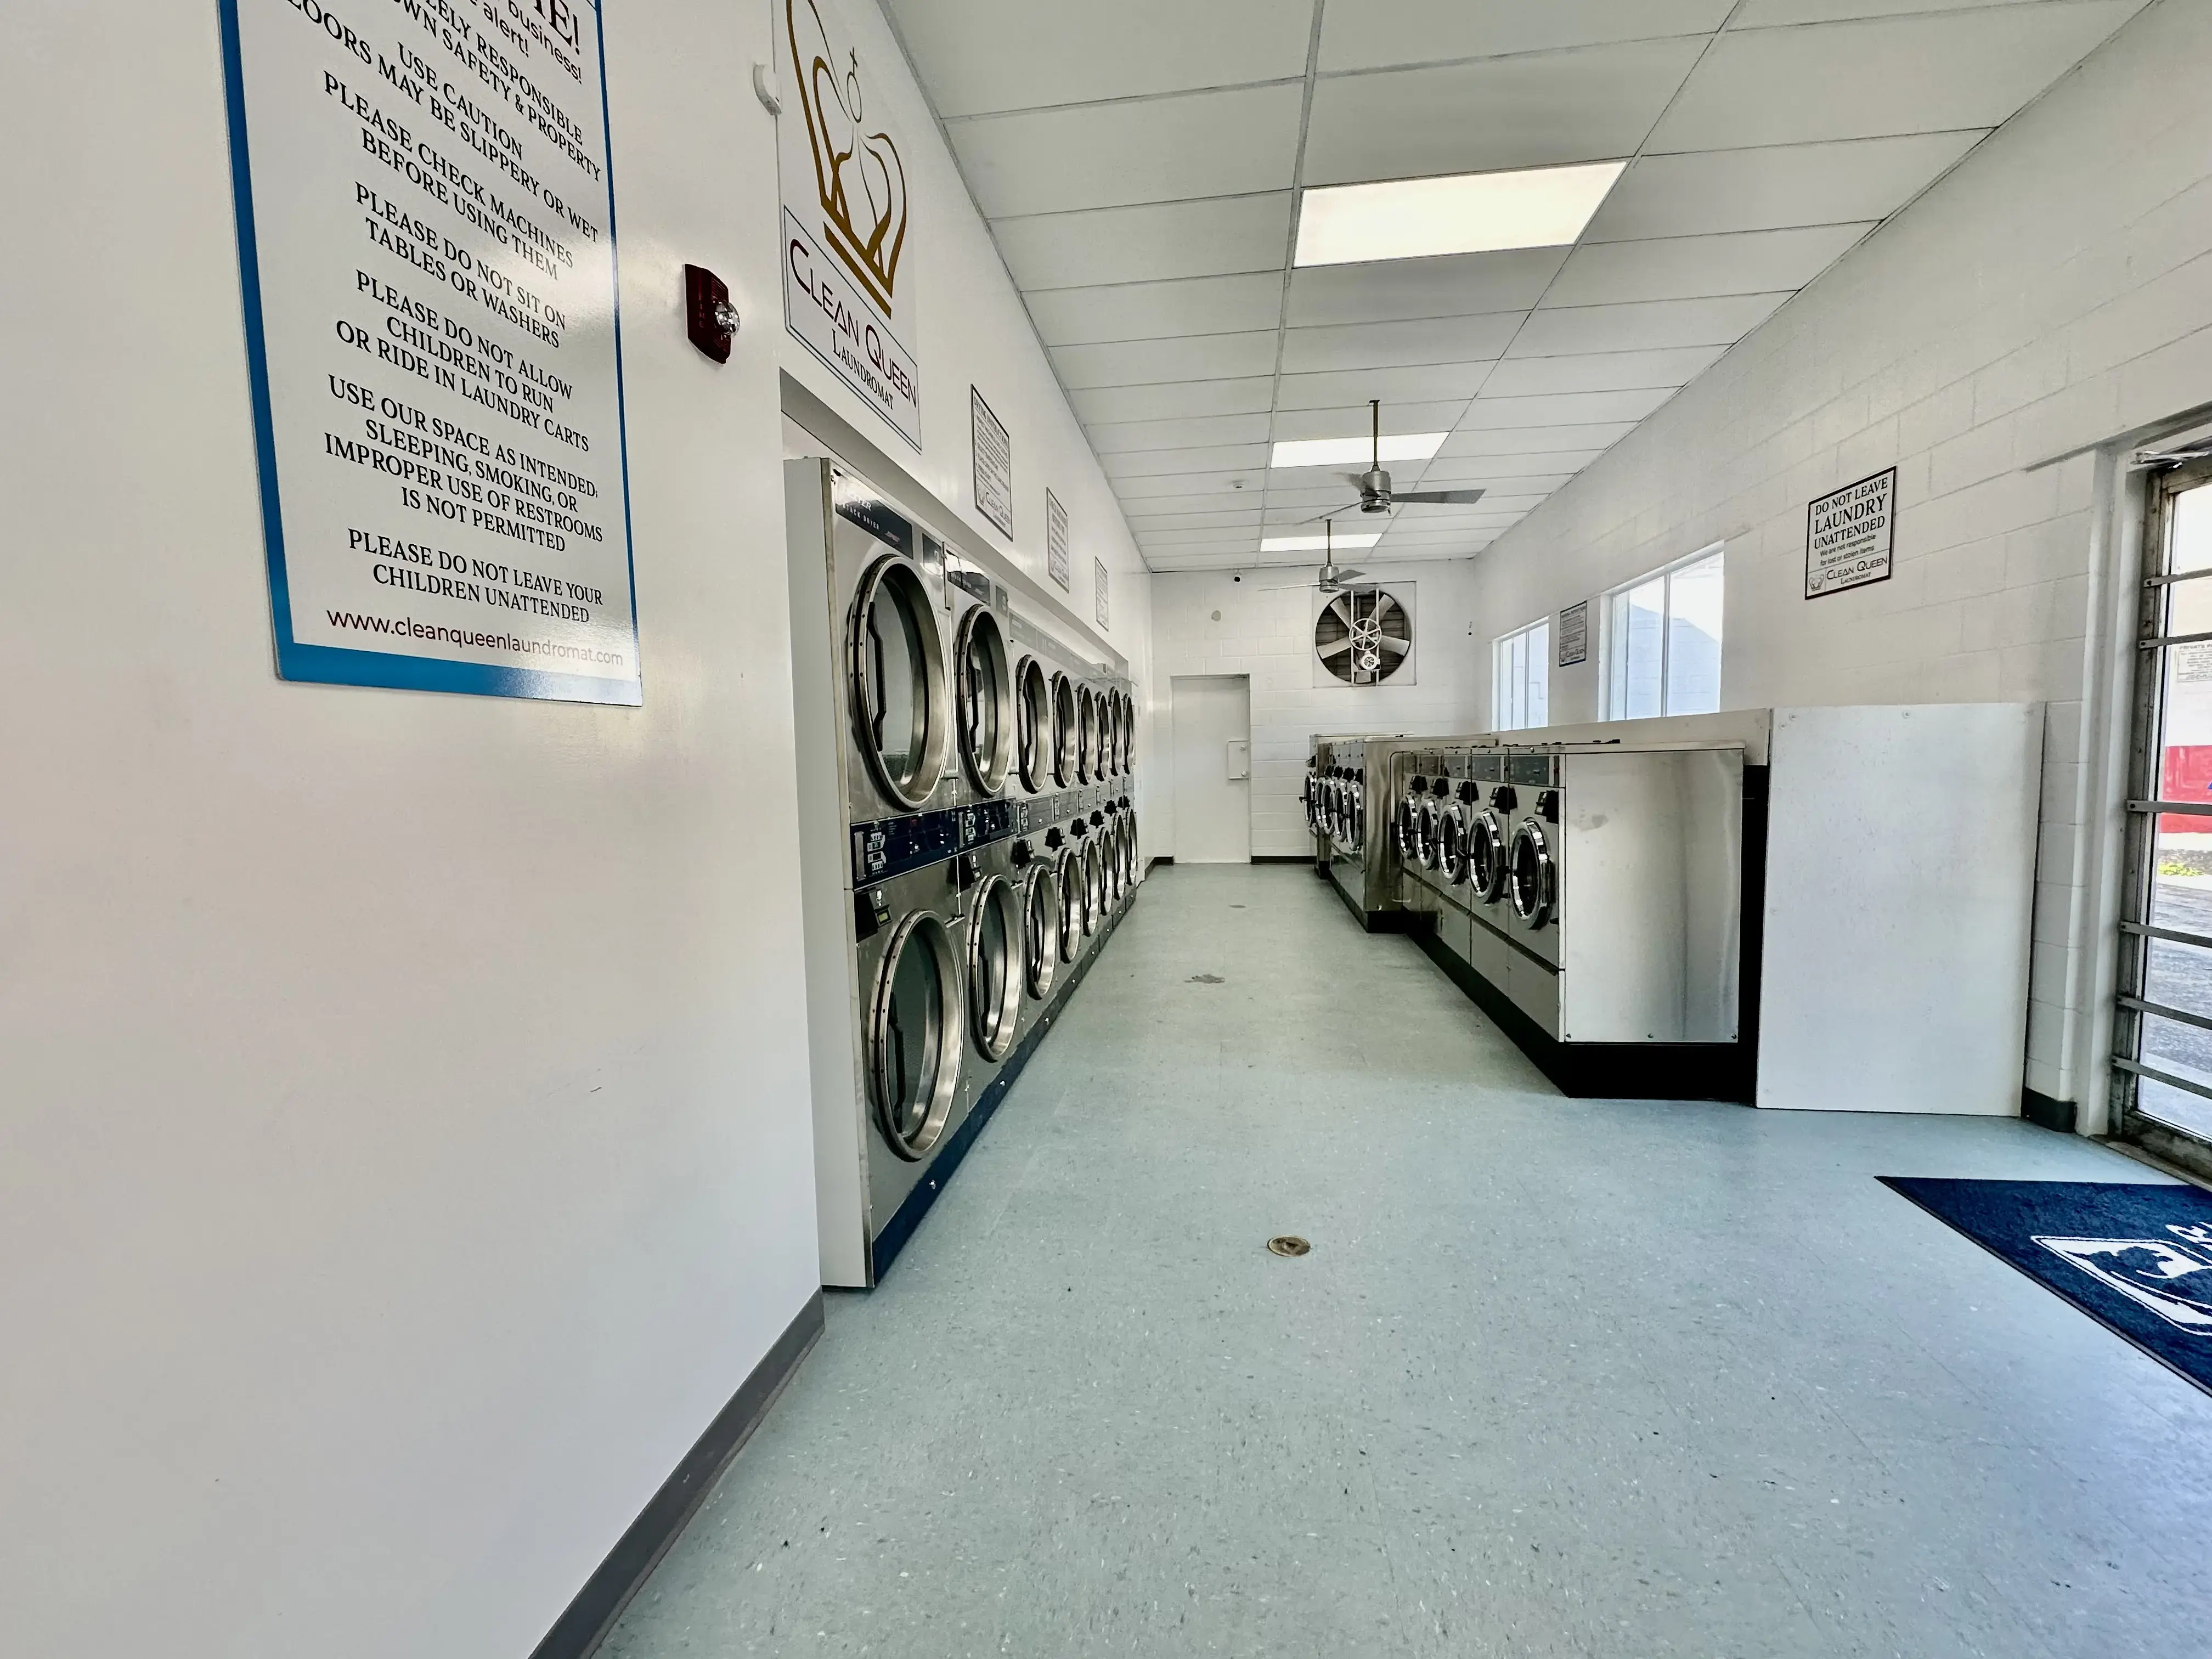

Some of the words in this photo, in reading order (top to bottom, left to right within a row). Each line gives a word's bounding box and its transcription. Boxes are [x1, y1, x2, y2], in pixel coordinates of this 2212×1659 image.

[483, 2, 529, 58] alert!
[393, 0, 437, 38] WN
[443, 29, 511, 101] SAFETY
[515, 94, 524, 115] &
[527, 104, 601, 182] PROPERTY
[398, 41, 438, 92] USE
[443, 83, 522, 161] CAUTION
[476, 32, 583, 146] RESPONSIBLE
[324, 70, 412, 153] PLEASE
[419, 143, 486, 206] CHECK
[490, 193, 573, 268] MACHINES
[378, 53, 424, 105] MAY
[430, 95, 455, 132] BE
[460, 121, 540, 197] SLIPPERY
[544, 189, 565, 218] OR
[567, 206, 598, 243] WET
[361, 127, 448, 205] BEFORE
[453, 192, 507, 244] USING
[511, 234, 557, 280] THEM
[355, 181, 438, 251] PLEASE
[443, 238, 471, 270] DO
[477, 259, 512, 296] NOT
[517, 286, 540, 313] SIT
[545, 305, 565, 330] ON
[365, 217, 445, 281] TABLES
[451, 272, 478, 301] OR
[481, 287, 558, 348] WASHERS
[356, 269, 439, 331] PLEASE
[444, 317, 472, 347] DO
[477, 335, 513, 369] NOT
[518, 359, 572, 399] ALLOW
[387, 317, 490, 382] CHILDREN
[495, 369, 517, 394] TO
[522, 383, 553, 413] RUN
[789, 239, 859, 347] CLEAN
[865, 324, 917, 408] QUEEN
[831, 328, 894, 410] LAUNDROMAT
[336, 320, 371, 353] OR
[376, 337, 428, 379] RIDE
[434, 365, 455, 391] IN
[461, 377, 540, 429] LAUNDRY
[544, 419, 589, 452] CARTS
[328, 374, 375, 411] USE
[381, 398, 428, 432] OUR
[432, 418, 490, 456] SPACE
[495, 444, 516, 466] AS
[520, 453, 597, 498] INTENDED;
[366, 419, 471, 476] SLEEPING,
[476, 460, 555, 506] SMOKING,
[557, 492, 578, 512] OR
[324, 432, 443, 490] IMPROPER
[447, 475, 483, 503] USE
[488, 490, 510, 511] OF
[515, 498, 602, 541] RESTROOMS
[401, 487, 421, 509] IS
[426, 494, 467, 523] NOT
[472, 509, 565, 551] PERMITTED
[1814, 515, 1886, 549] UNATTENDED
[1815, 501, 1829, 516] DO
[1832, 492, 1852, 509] NOT
[1855, 477, 1888, 500] LEAVE
[1815, 493, 1887, 535] LAUNDRY
[348, 528, 433, 566] PLEASE
[438, 550, 467, 573] DO
[472, 559, 509, 583] NOT
[513, 569, 562, 596] LEAVE
[566, 582, 603, 605] YOUR
[1826, 566, 1854, 580] CLEAN
[1857, 556, 1887, 572] QUEEN
[1843, 550, 1859, 560] stolen
[1847, 534, 1876, 548] responsible
[326, 610, 623, 667] www.cleanqueenlaundromat.com
[373, 564, 479, 602] CHILDREN
[484, 587, 589, 622] UNATTENDED
